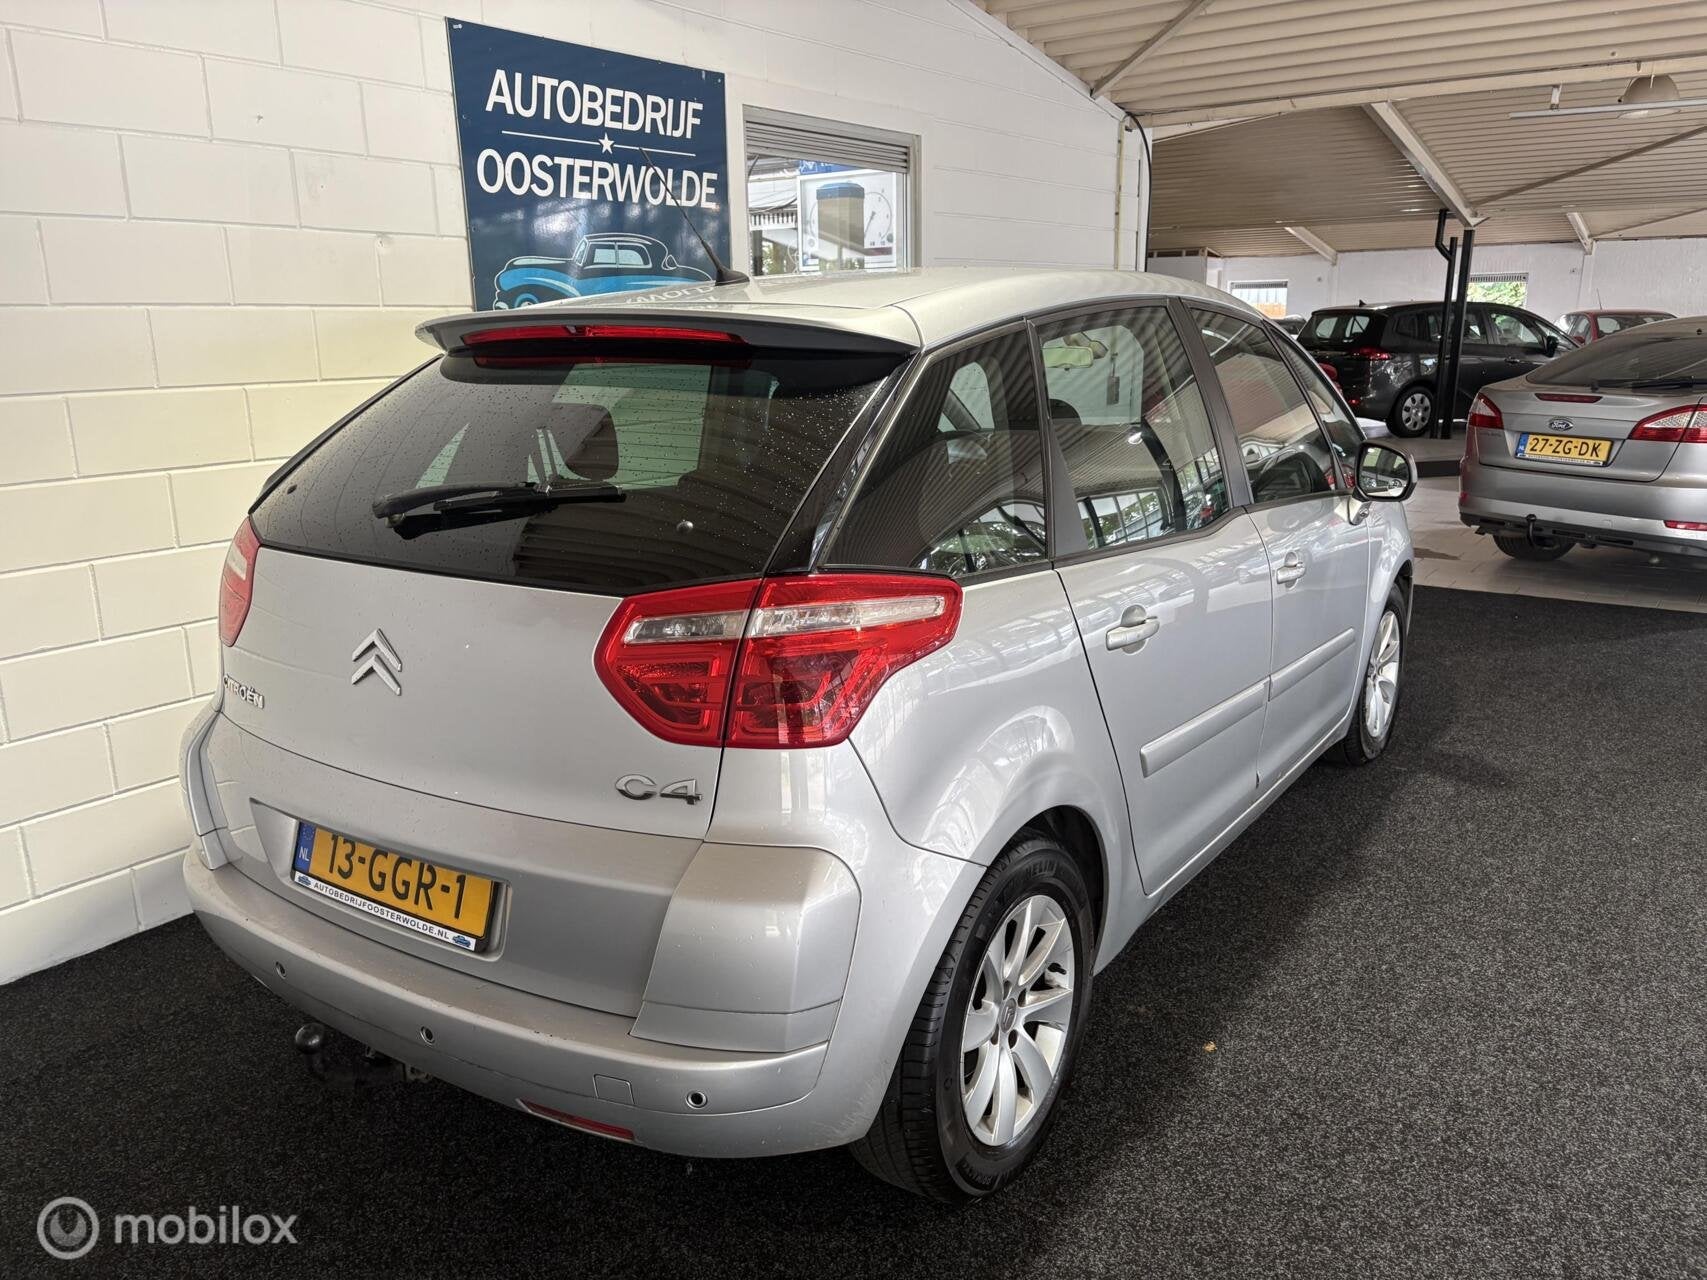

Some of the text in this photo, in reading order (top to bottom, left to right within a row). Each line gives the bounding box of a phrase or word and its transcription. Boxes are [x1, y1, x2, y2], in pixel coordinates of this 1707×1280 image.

[485, 69, 703, 138] AUTOBEDRIJF
[477, 149, 718, 208] OOSTERWOLDE
[1551, 420, 1567, 429] Ford
[1529, 437, 1601, 457] 27-ZG-DK
[615, 774, 702, 805] C4
[299, 846, 310, 861] NL
[328, 834, 467, 919] 13-GGR-1
[313, 882, 450, 940] AUTOBEDRIJFOOSTERWOLDE.NL
